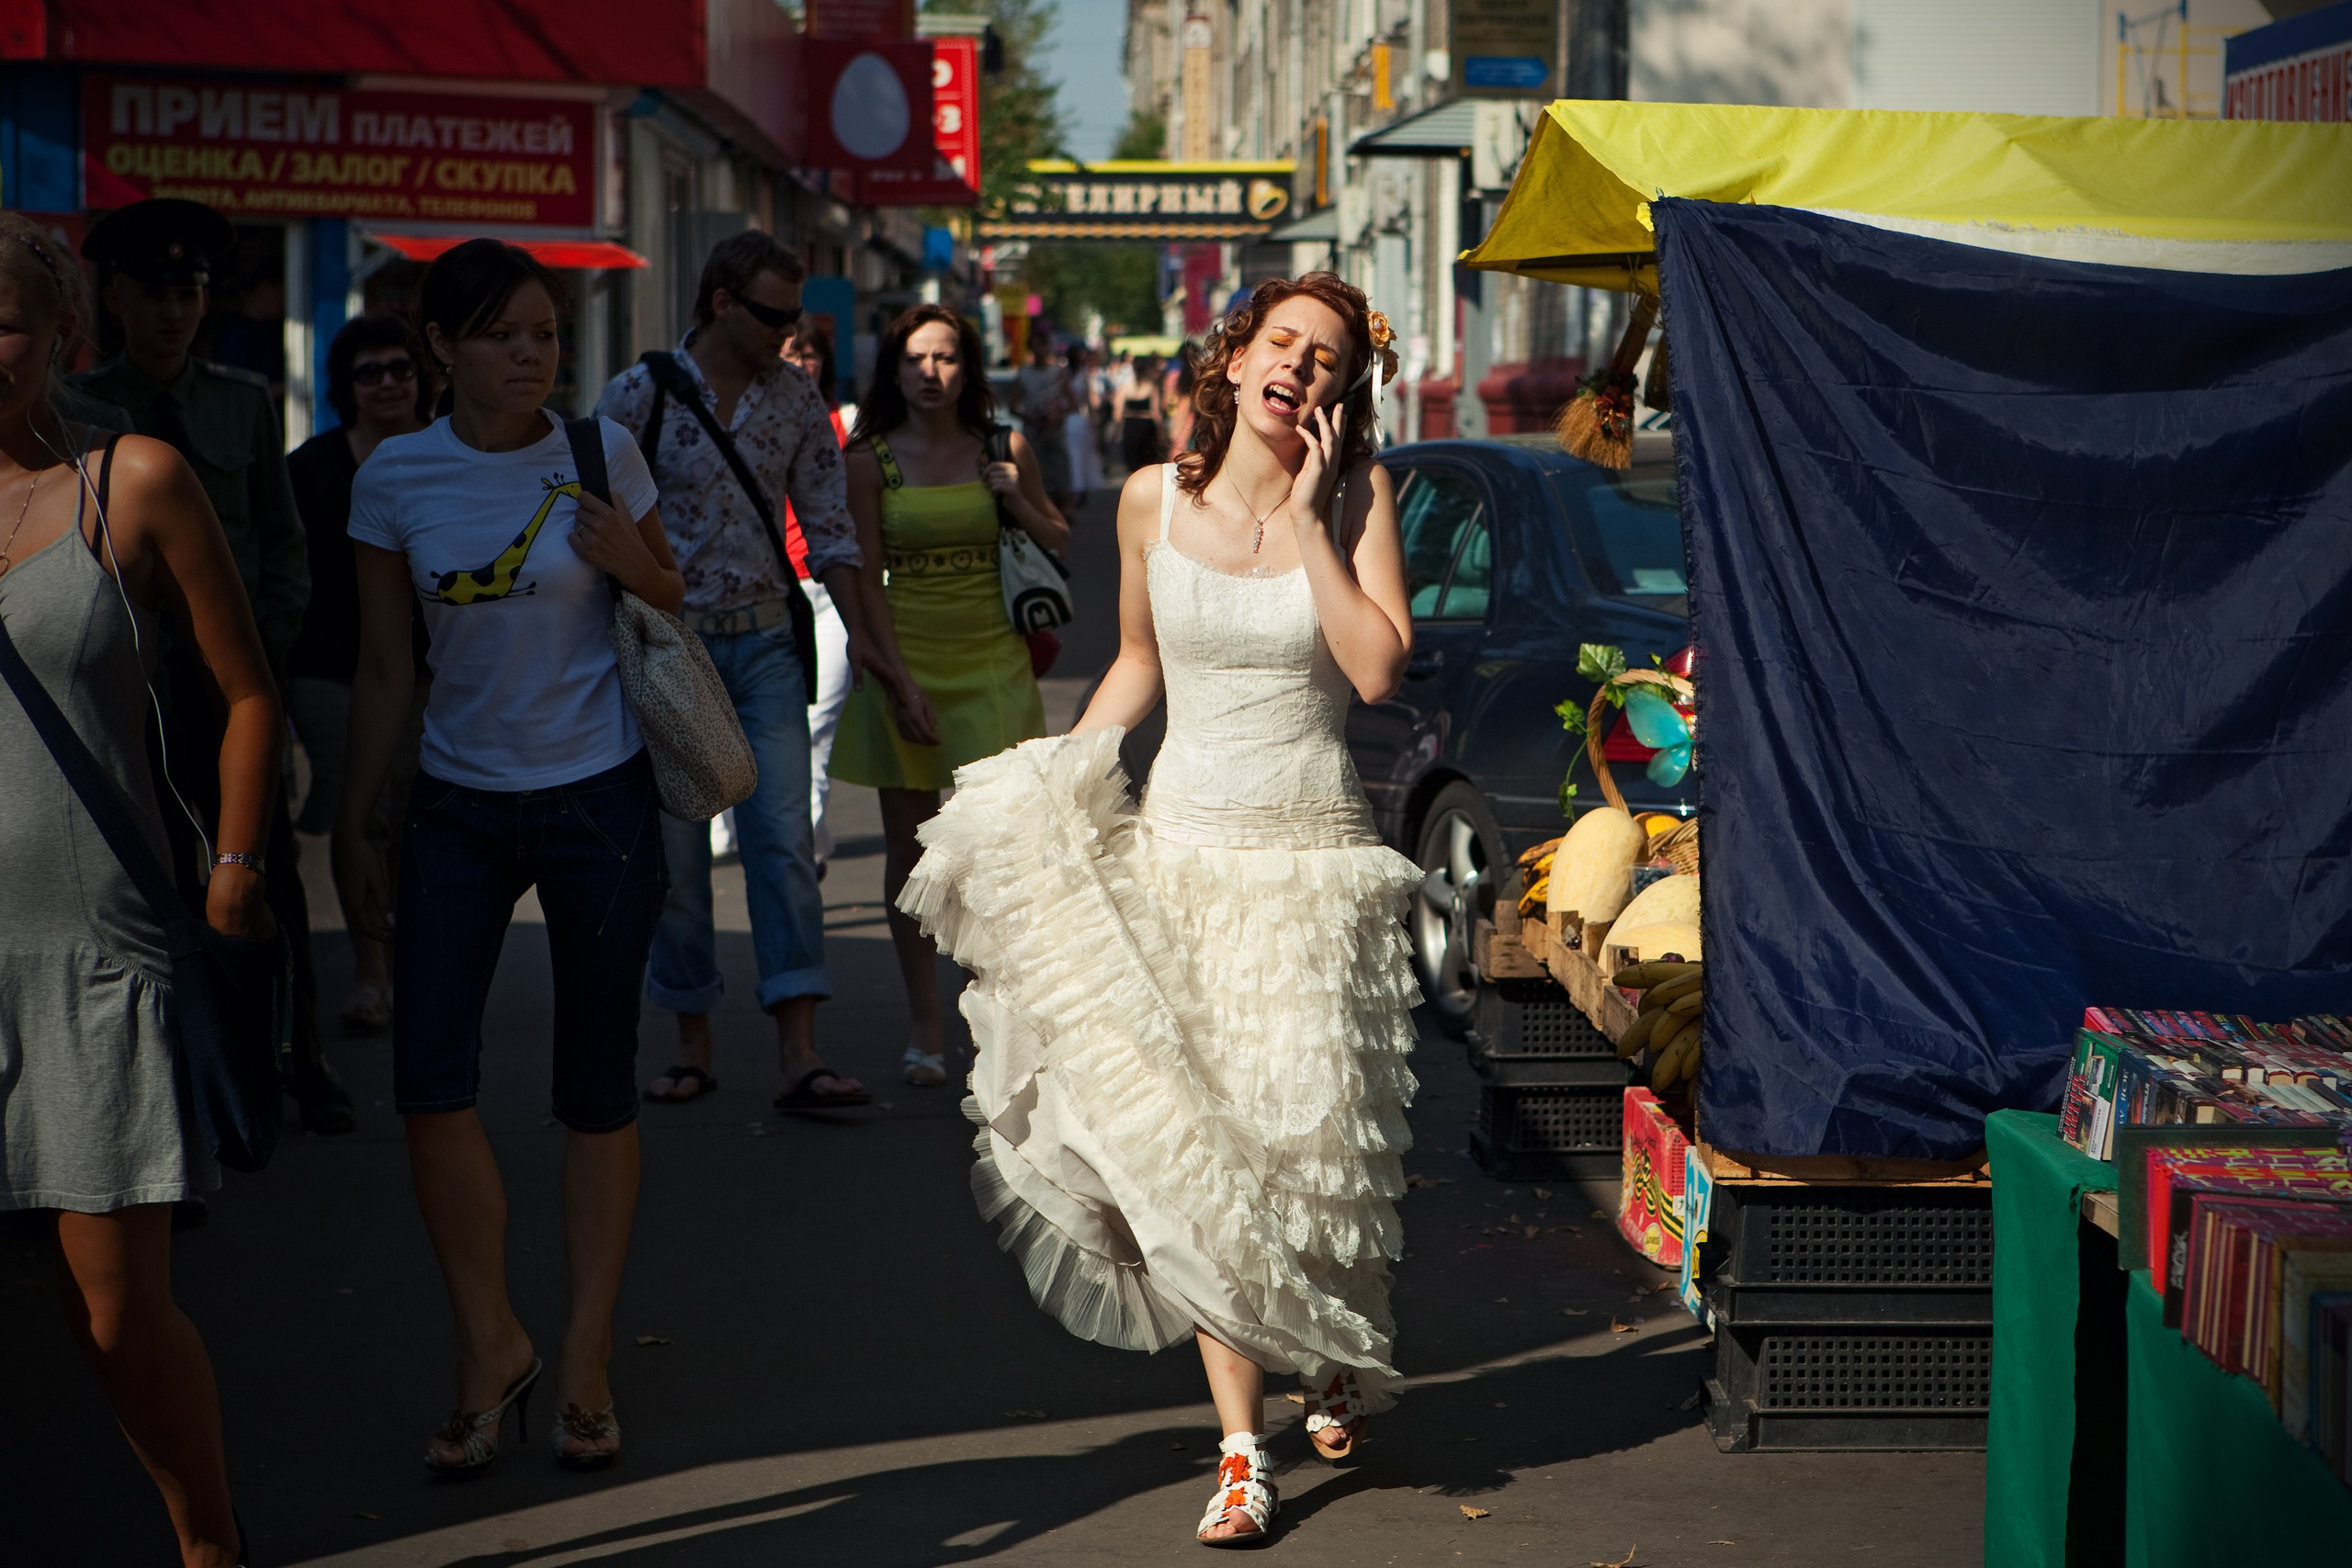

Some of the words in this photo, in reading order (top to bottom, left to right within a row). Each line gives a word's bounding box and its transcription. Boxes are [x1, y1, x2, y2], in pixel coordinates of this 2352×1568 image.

[110, 88, 341, 144] ПРИЕМ
[352, 111, 573, 155] ПЛАТЕЖЕЙ
[105, 141, 266, 183] ОЦЕНКА
[289, 151, 411, 187] ЗАЛОГ
[434, 157, 577, 196] СКУПКА
